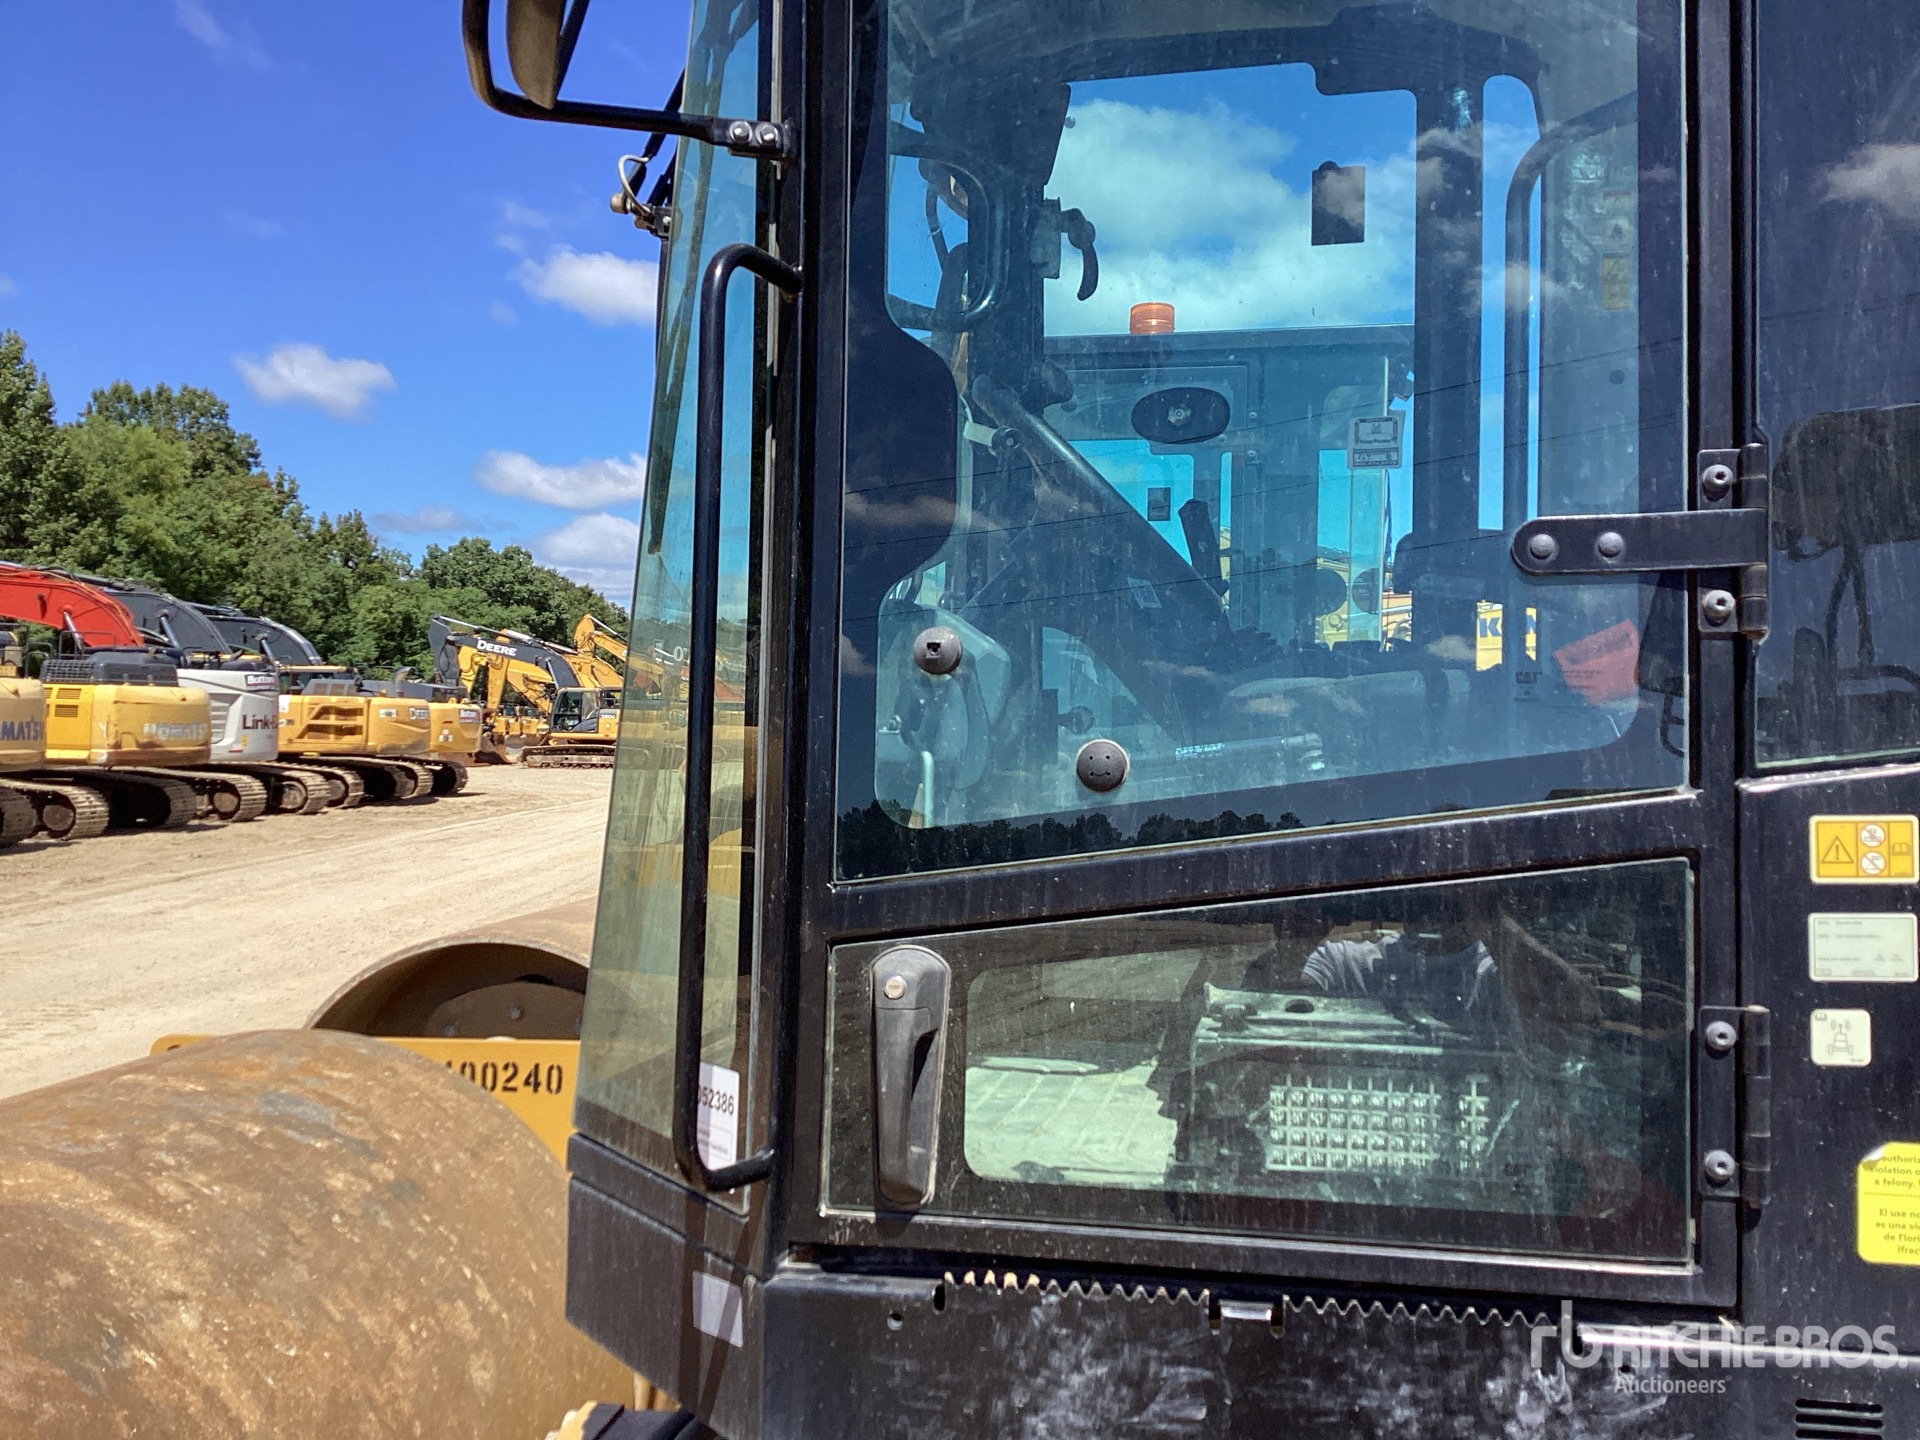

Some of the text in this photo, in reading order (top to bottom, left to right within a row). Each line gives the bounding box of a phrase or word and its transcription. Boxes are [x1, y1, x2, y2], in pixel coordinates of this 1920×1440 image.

[477, 639, 517, 657] DEERE
[1888, 1222, 1906, 1230] una
[1883, 1232, 1896, 1241] de
